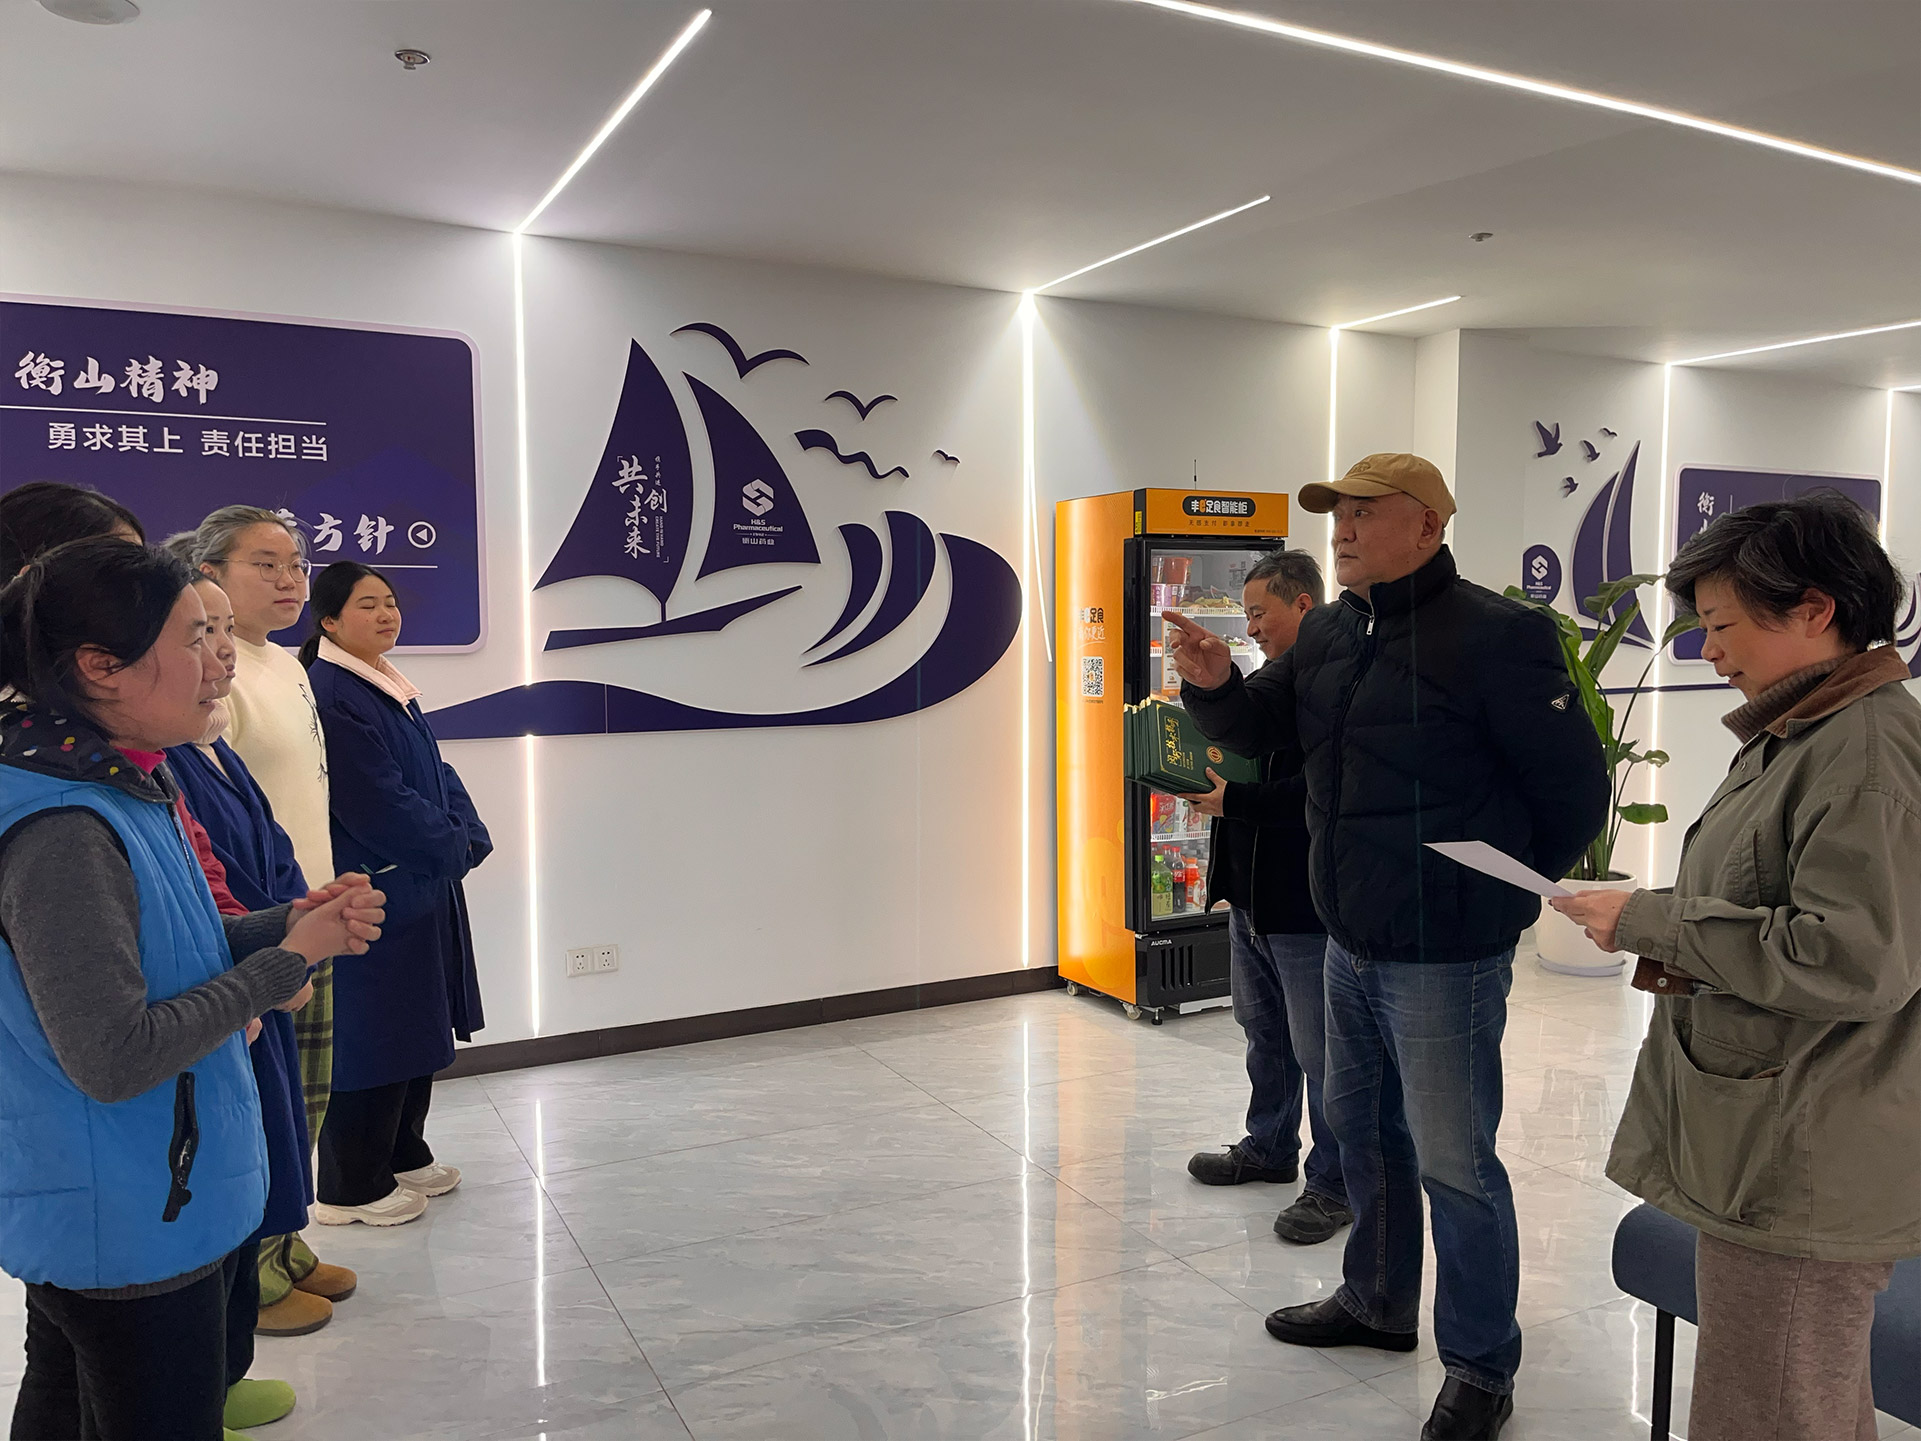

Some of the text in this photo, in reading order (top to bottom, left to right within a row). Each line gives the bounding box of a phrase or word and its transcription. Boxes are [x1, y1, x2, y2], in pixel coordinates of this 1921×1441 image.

[14, 351, 219, 405] 衡山精神
[47, 422, 329, 462] 勇求其上 责任担当
[733, 523, 783, 532] Pharmaceutical
